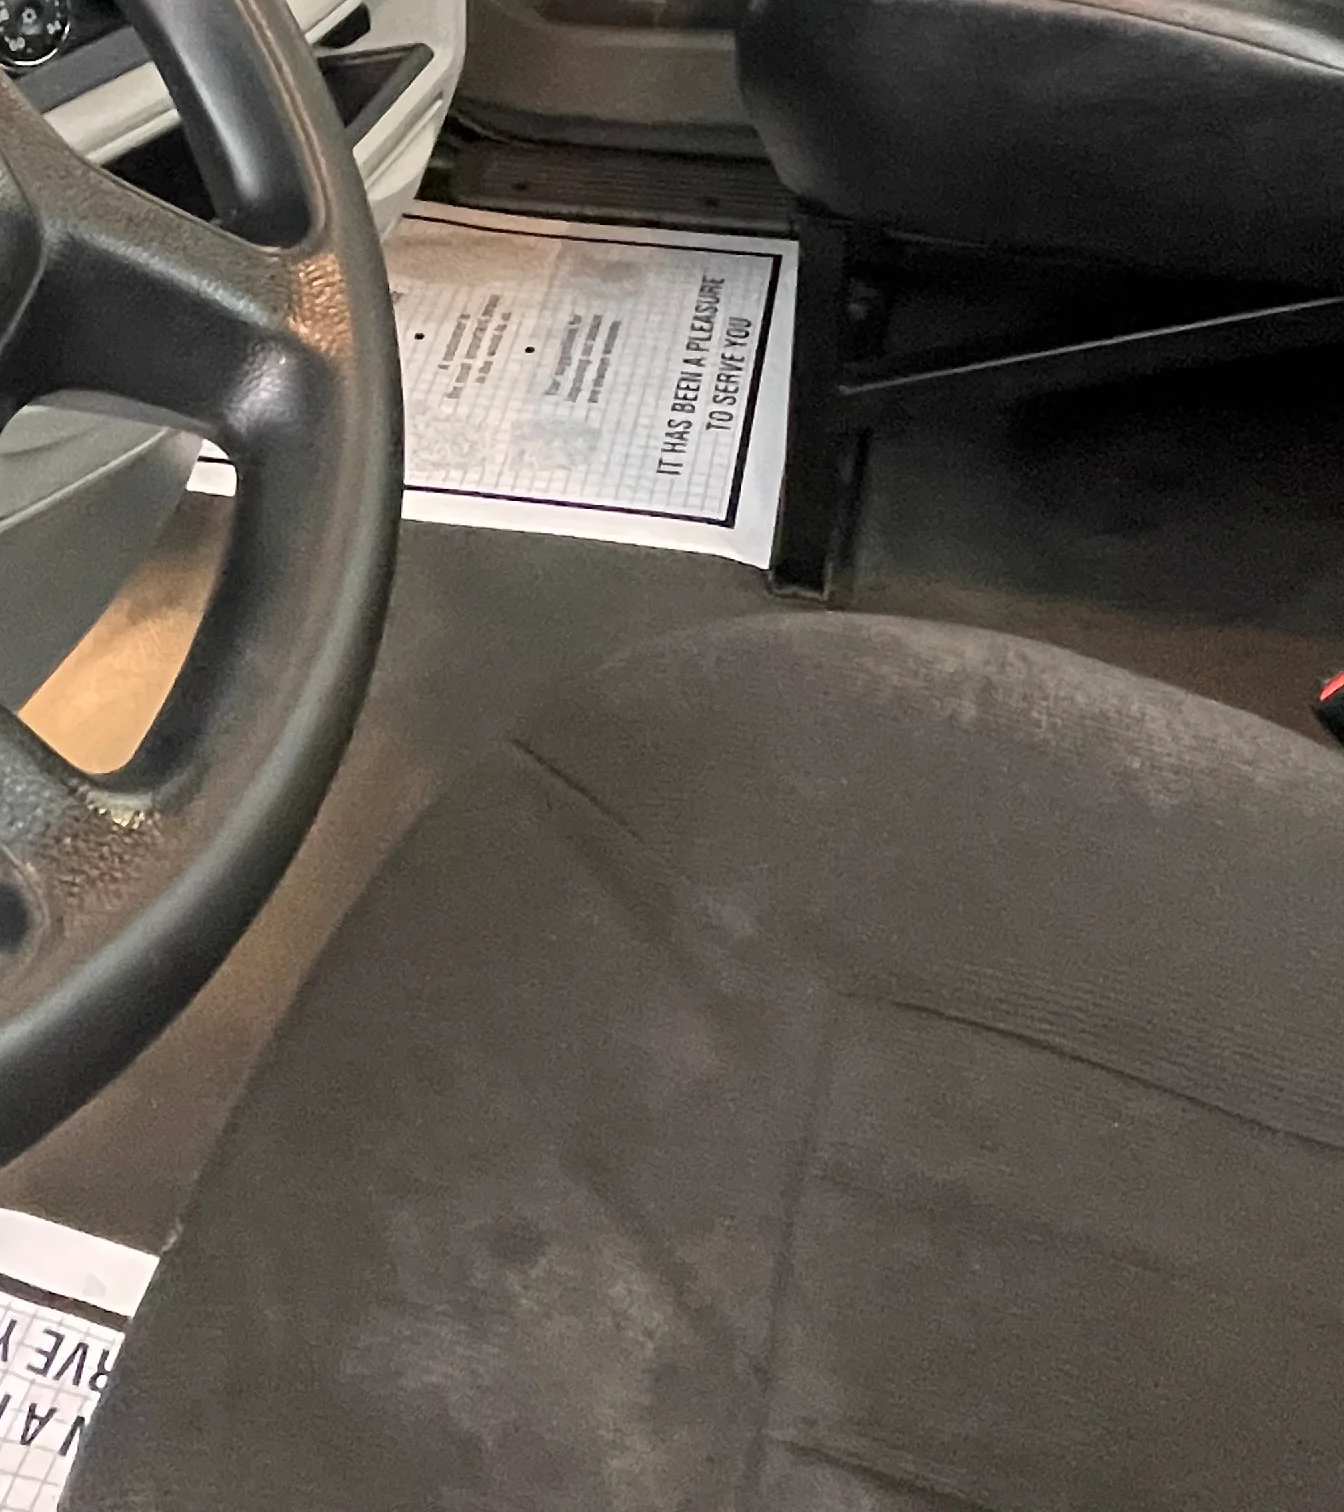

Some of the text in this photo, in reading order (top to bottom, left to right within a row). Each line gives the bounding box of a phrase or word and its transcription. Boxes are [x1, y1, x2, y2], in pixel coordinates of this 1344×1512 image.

[656, 275, 725, 475] IT HAS BEEN A PLEASURE
[705, 316, 752, 431] TO SERVE YOU
[19, 1402, 58, 1446] A
